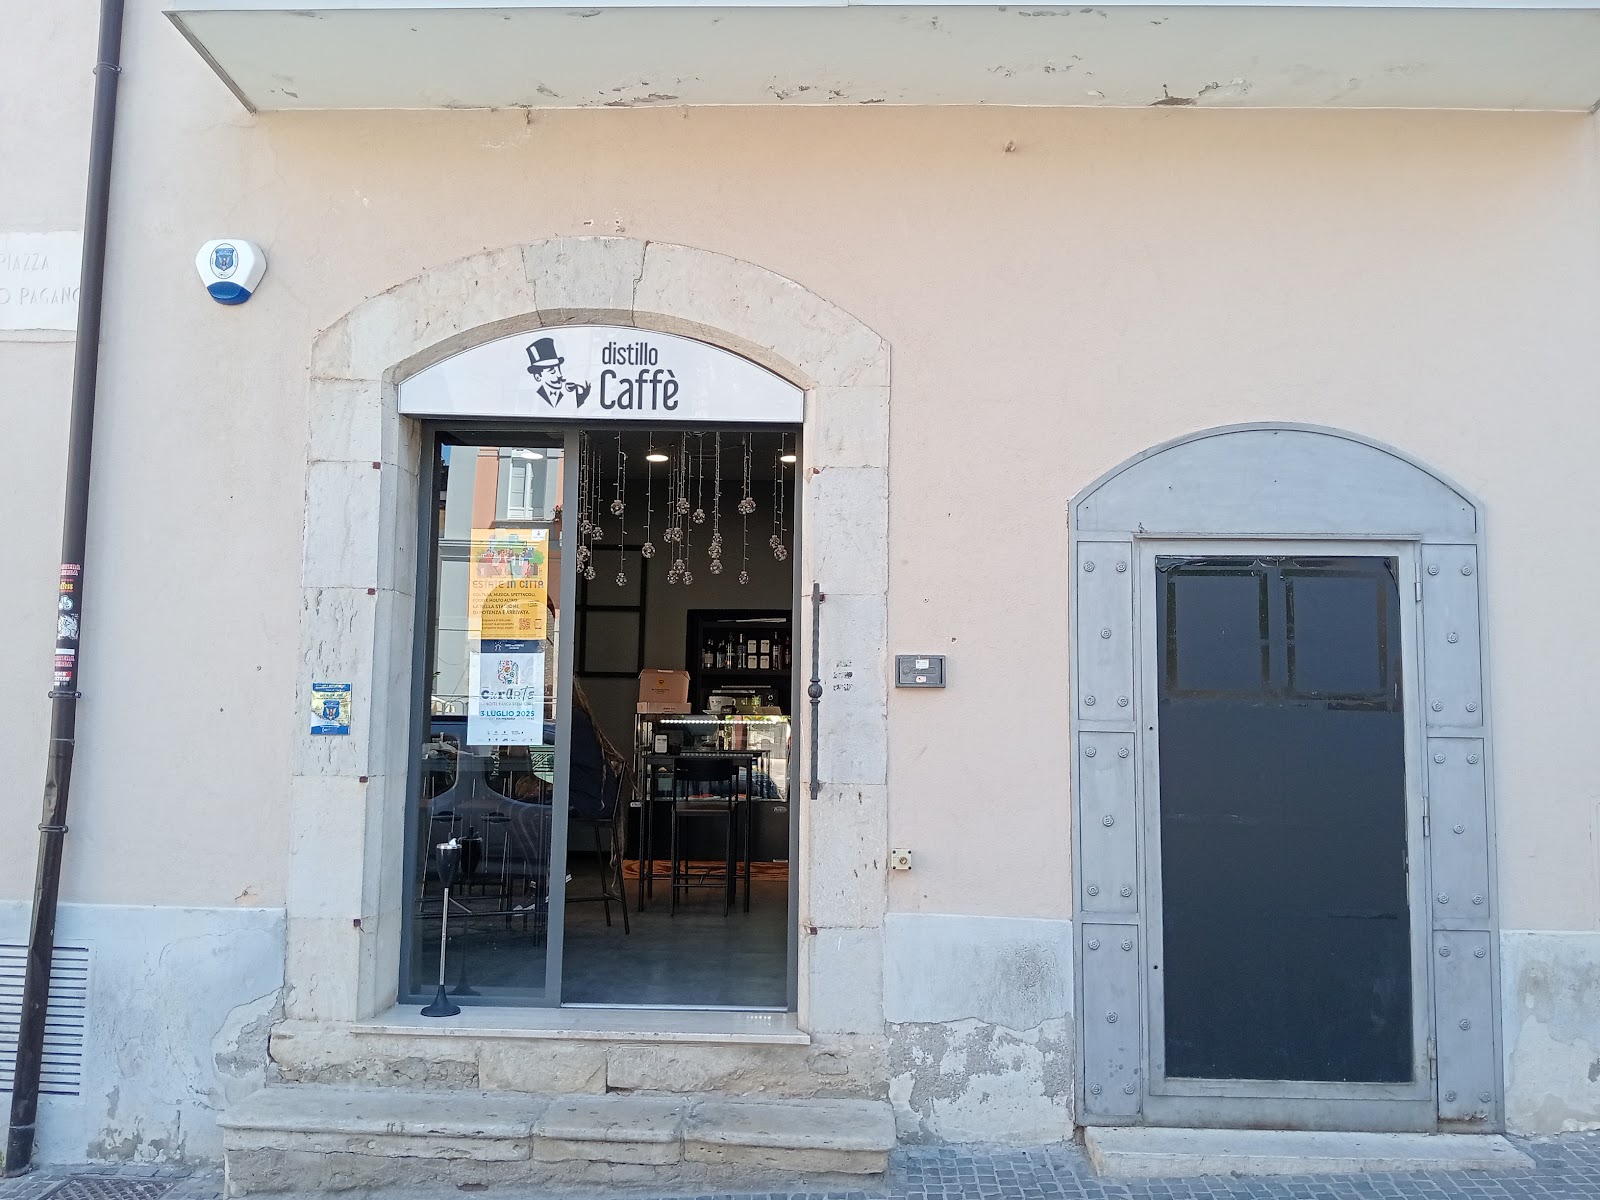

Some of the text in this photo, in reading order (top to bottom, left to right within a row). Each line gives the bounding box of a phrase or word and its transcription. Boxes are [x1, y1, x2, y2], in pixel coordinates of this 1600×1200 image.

[602, 341, 658, 366] distillo
[600, 369, 679, 411] Caffè
[472, 580, 504, 589] ESTATE
